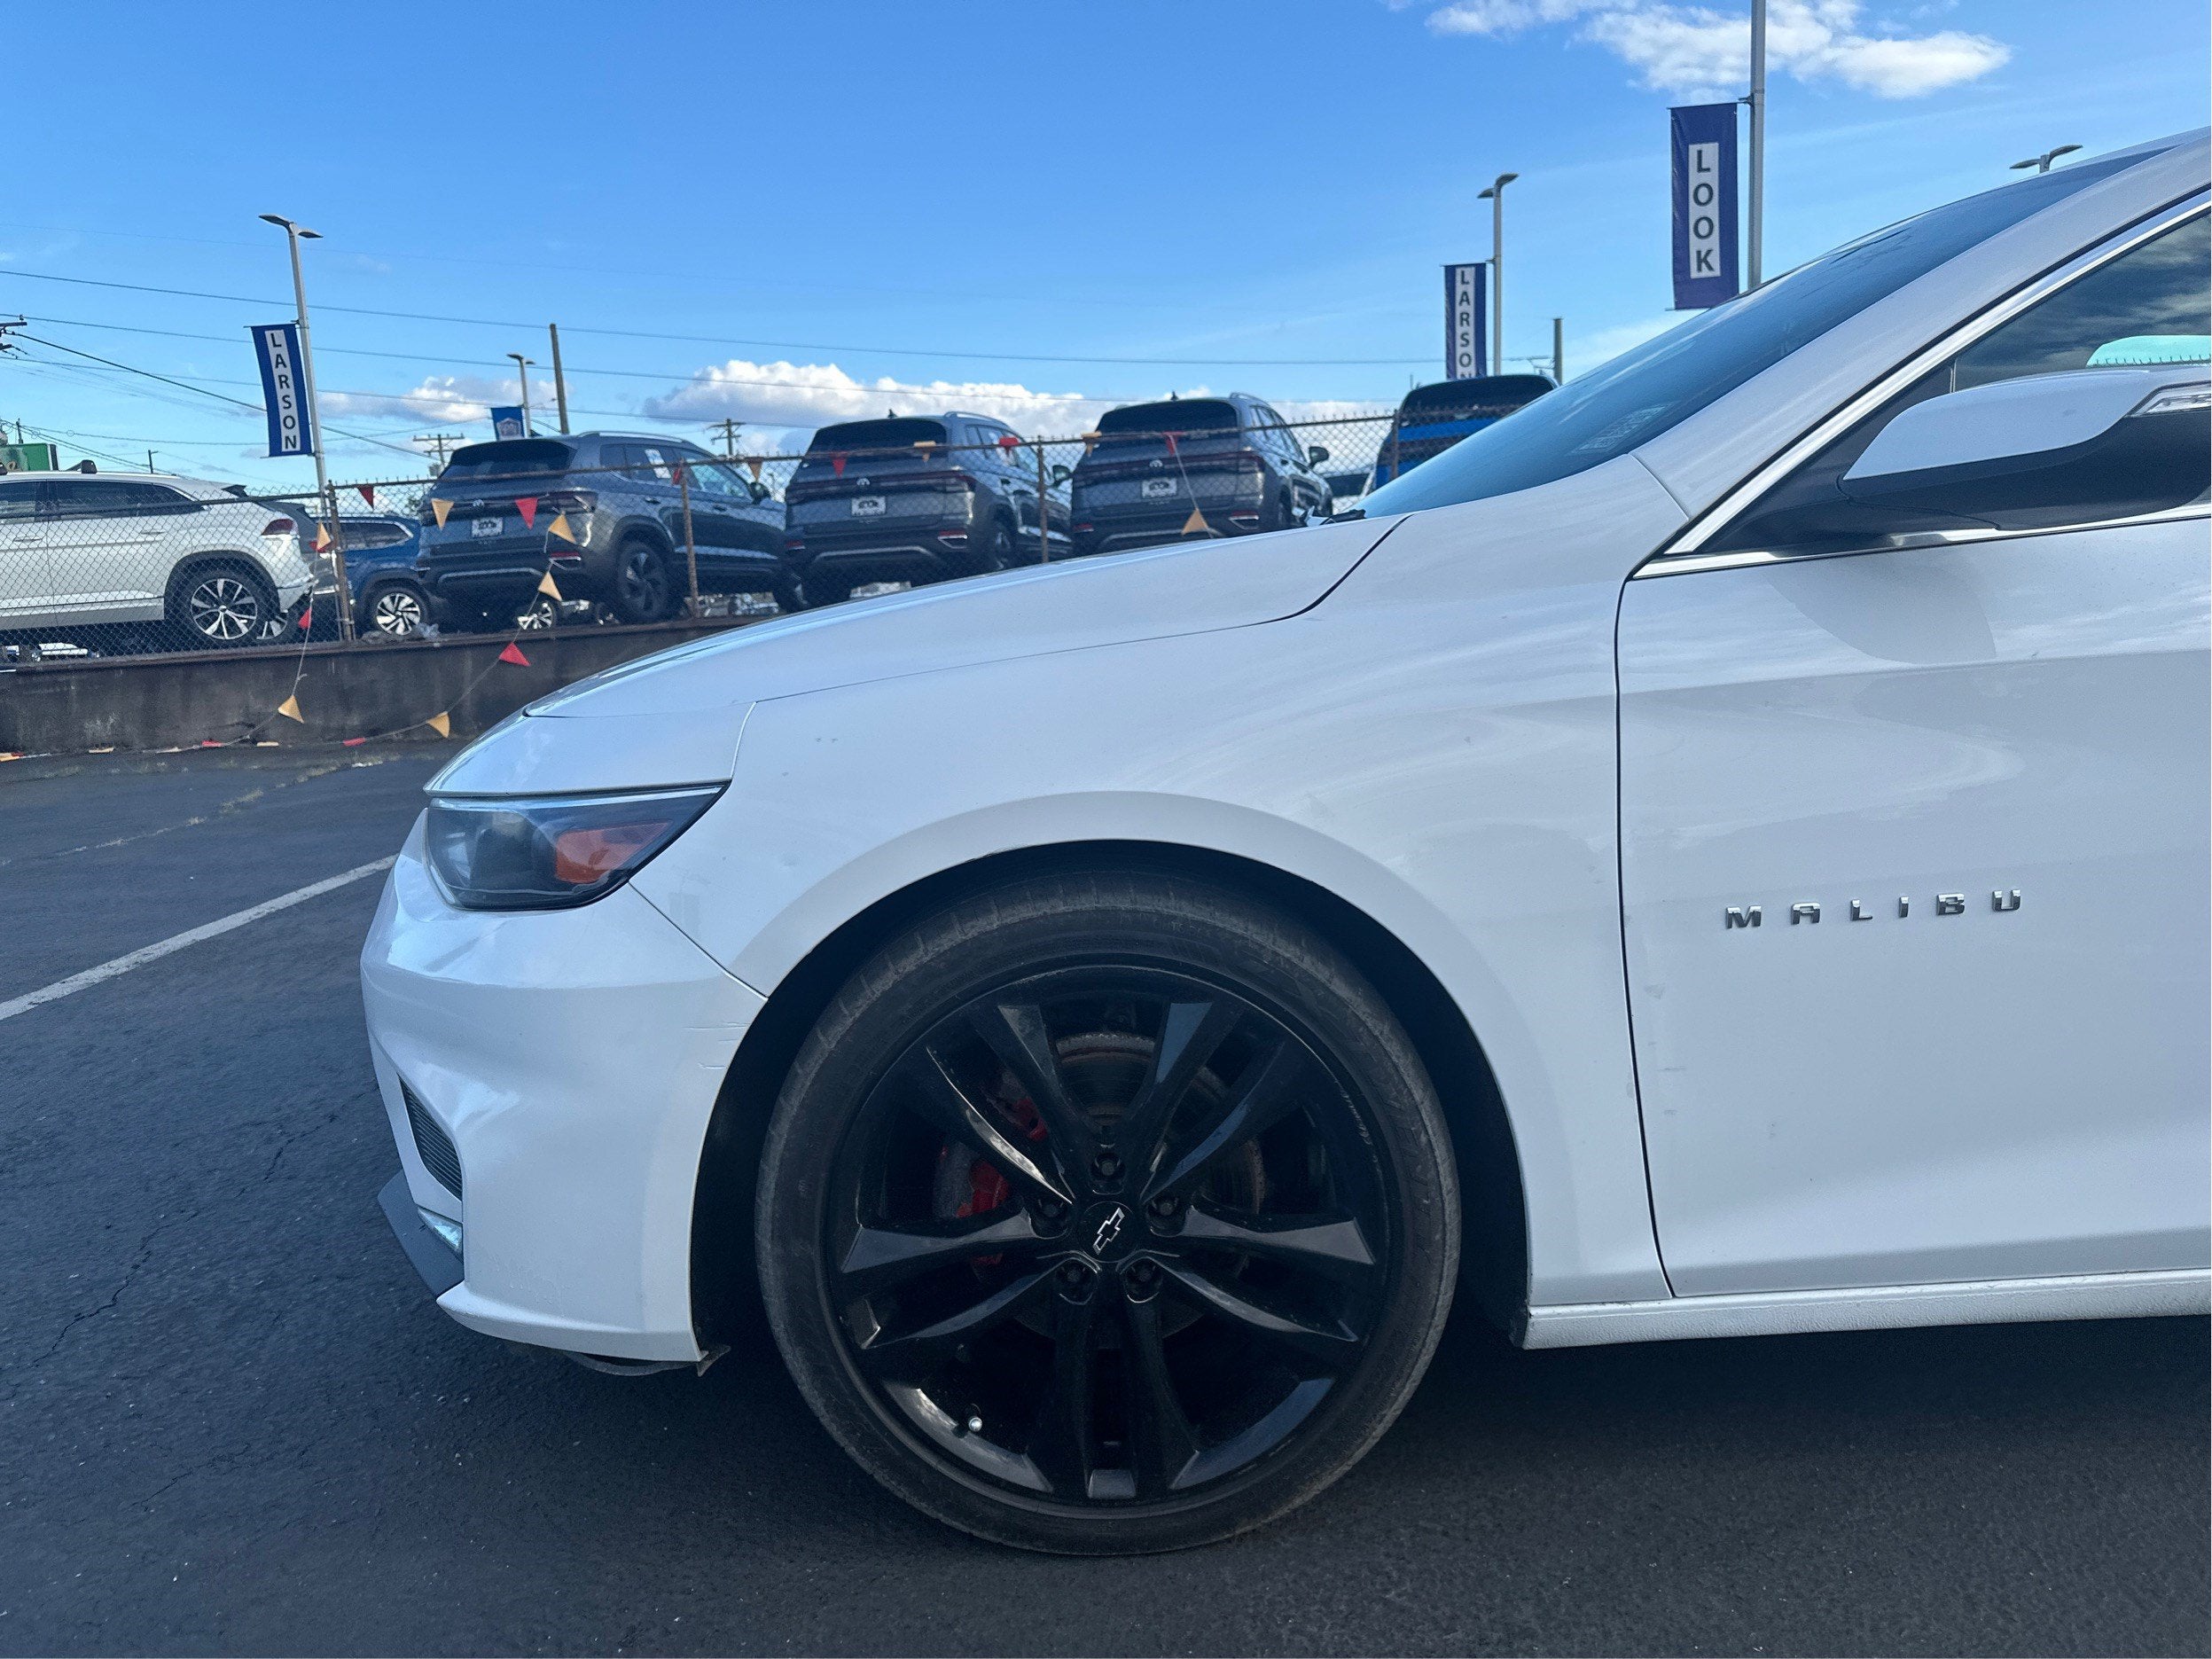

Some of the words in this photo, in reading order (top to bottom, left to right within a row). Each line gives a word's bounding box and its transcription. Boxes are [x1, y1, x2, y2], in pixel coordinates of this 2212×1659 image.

[1692, 149, 1715, 273] LOOK
[270, 333, 297, 450] LARSON
[1725, 888, 2021, 929] MALIBU
